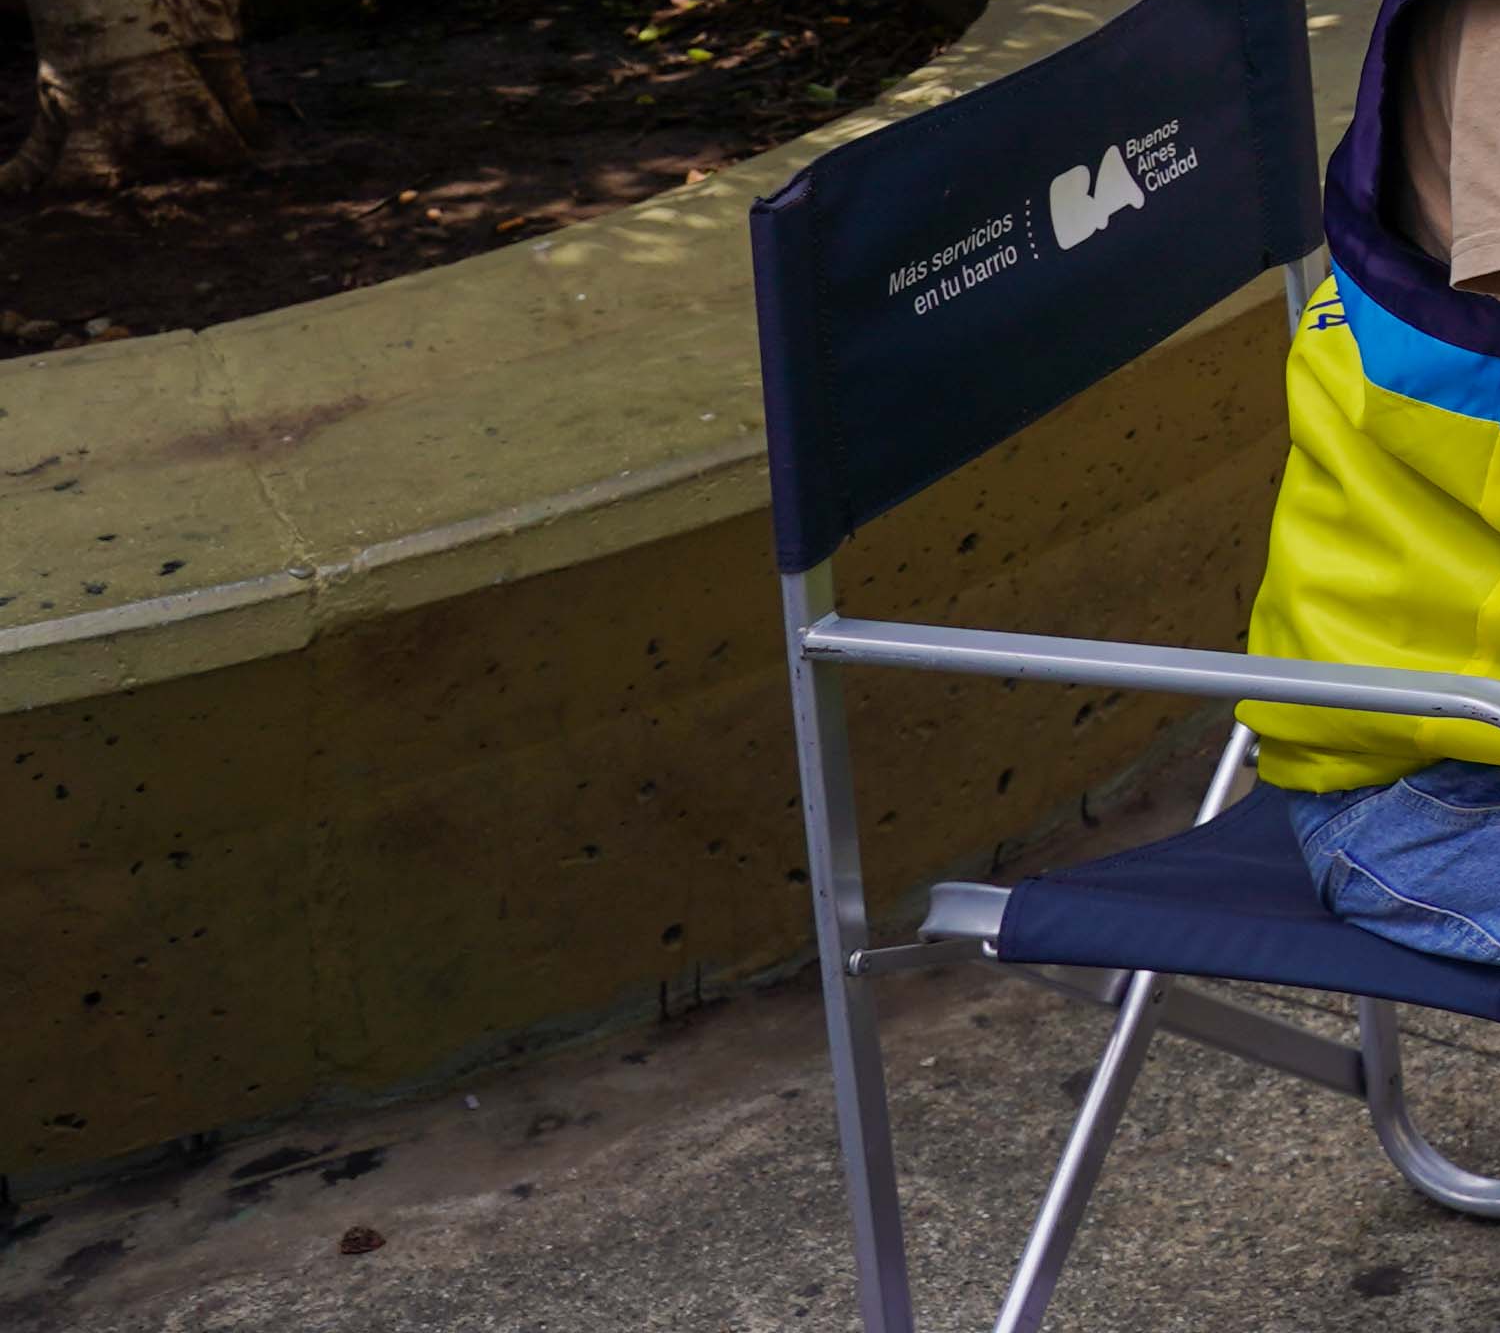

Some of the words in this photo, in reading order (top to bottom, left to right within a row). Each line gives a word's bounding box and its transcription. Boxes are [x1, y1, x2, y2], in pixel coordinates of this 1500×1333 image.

[1125, 117, 1179, 159] Buenos
[1136, 140, 1177, 176] Aires
[1049, 143, 1146, 251] BA
[1143, 146, 1199, 192] Ciudad
[887, 256, 929, 297] Más
[931, 211, 1014, 272] servicios
[912, 288, 940, 317] en
[938, 275, 962, 303] tu
[961, 241, 1019, 290] barrio
